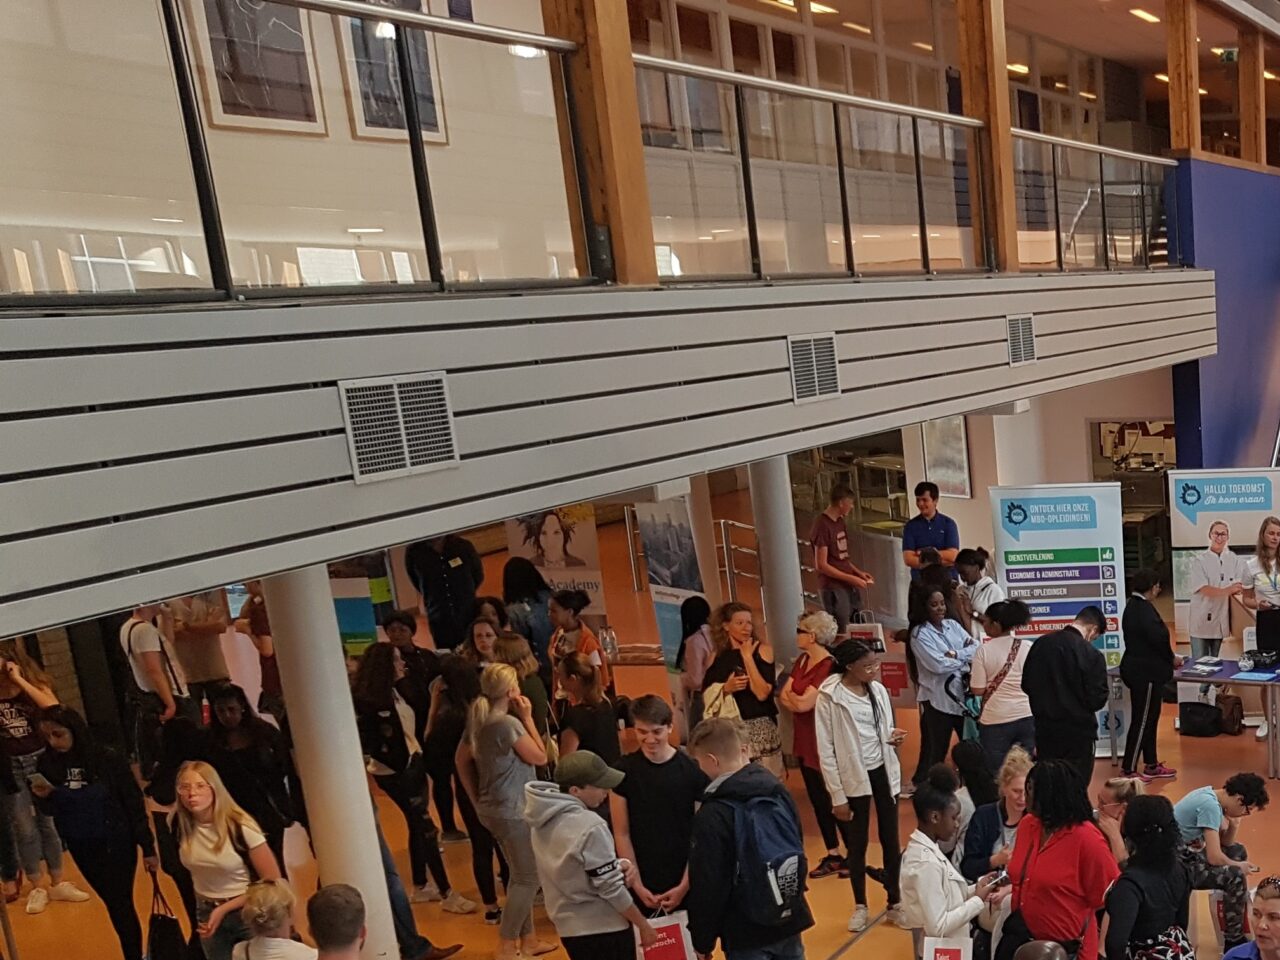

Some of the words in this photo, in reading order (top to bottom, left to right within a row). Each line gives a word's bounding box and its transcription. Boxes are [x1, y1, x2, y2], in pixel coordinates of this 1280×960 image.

[1204, 484, 1226, 494] HALLO
[1228, 483, 1265, 493] TOEKOMST
[1204, 495, 1217, 504] Ik
[1218, 495, 1238, 503] kom
[1029, 504, 1055, 513] ONTDEK
[1056, 503, 1072, 512] HIER
[1072, 503, 1089, 512] ONZE
[1008, 553, 1054, 562] DIENSTVERLENING
[1009, 571, 1035, 579] ECONOMIE
[1042, 570, 1080, 578] ADMINISTRATIE
[549, 578, 600, 591] Academy
